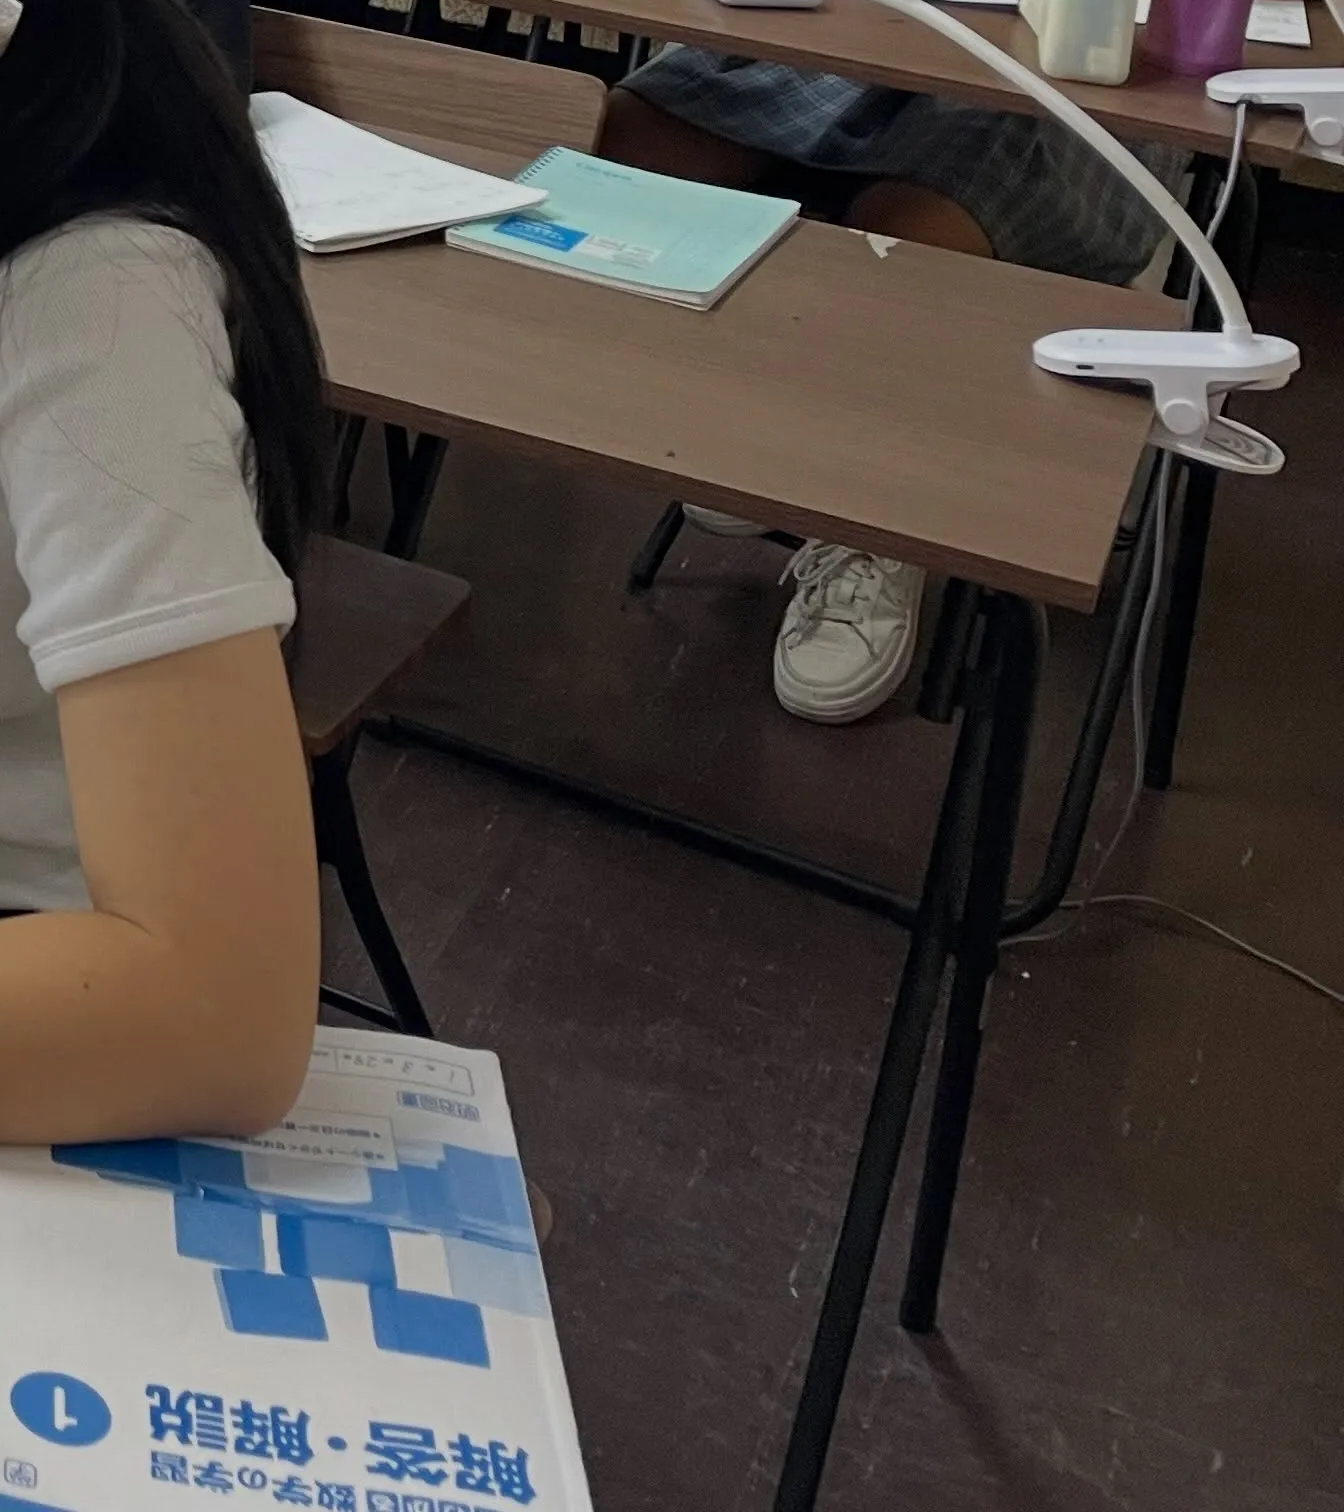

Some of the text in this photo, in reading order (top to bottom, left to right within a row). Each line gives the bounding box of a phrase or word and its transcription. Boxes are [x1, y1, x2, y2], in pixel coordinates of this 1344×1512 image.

[53, 1385, 79, 1432] 1
[145, 1384, 538, 1506] 解答・解説
